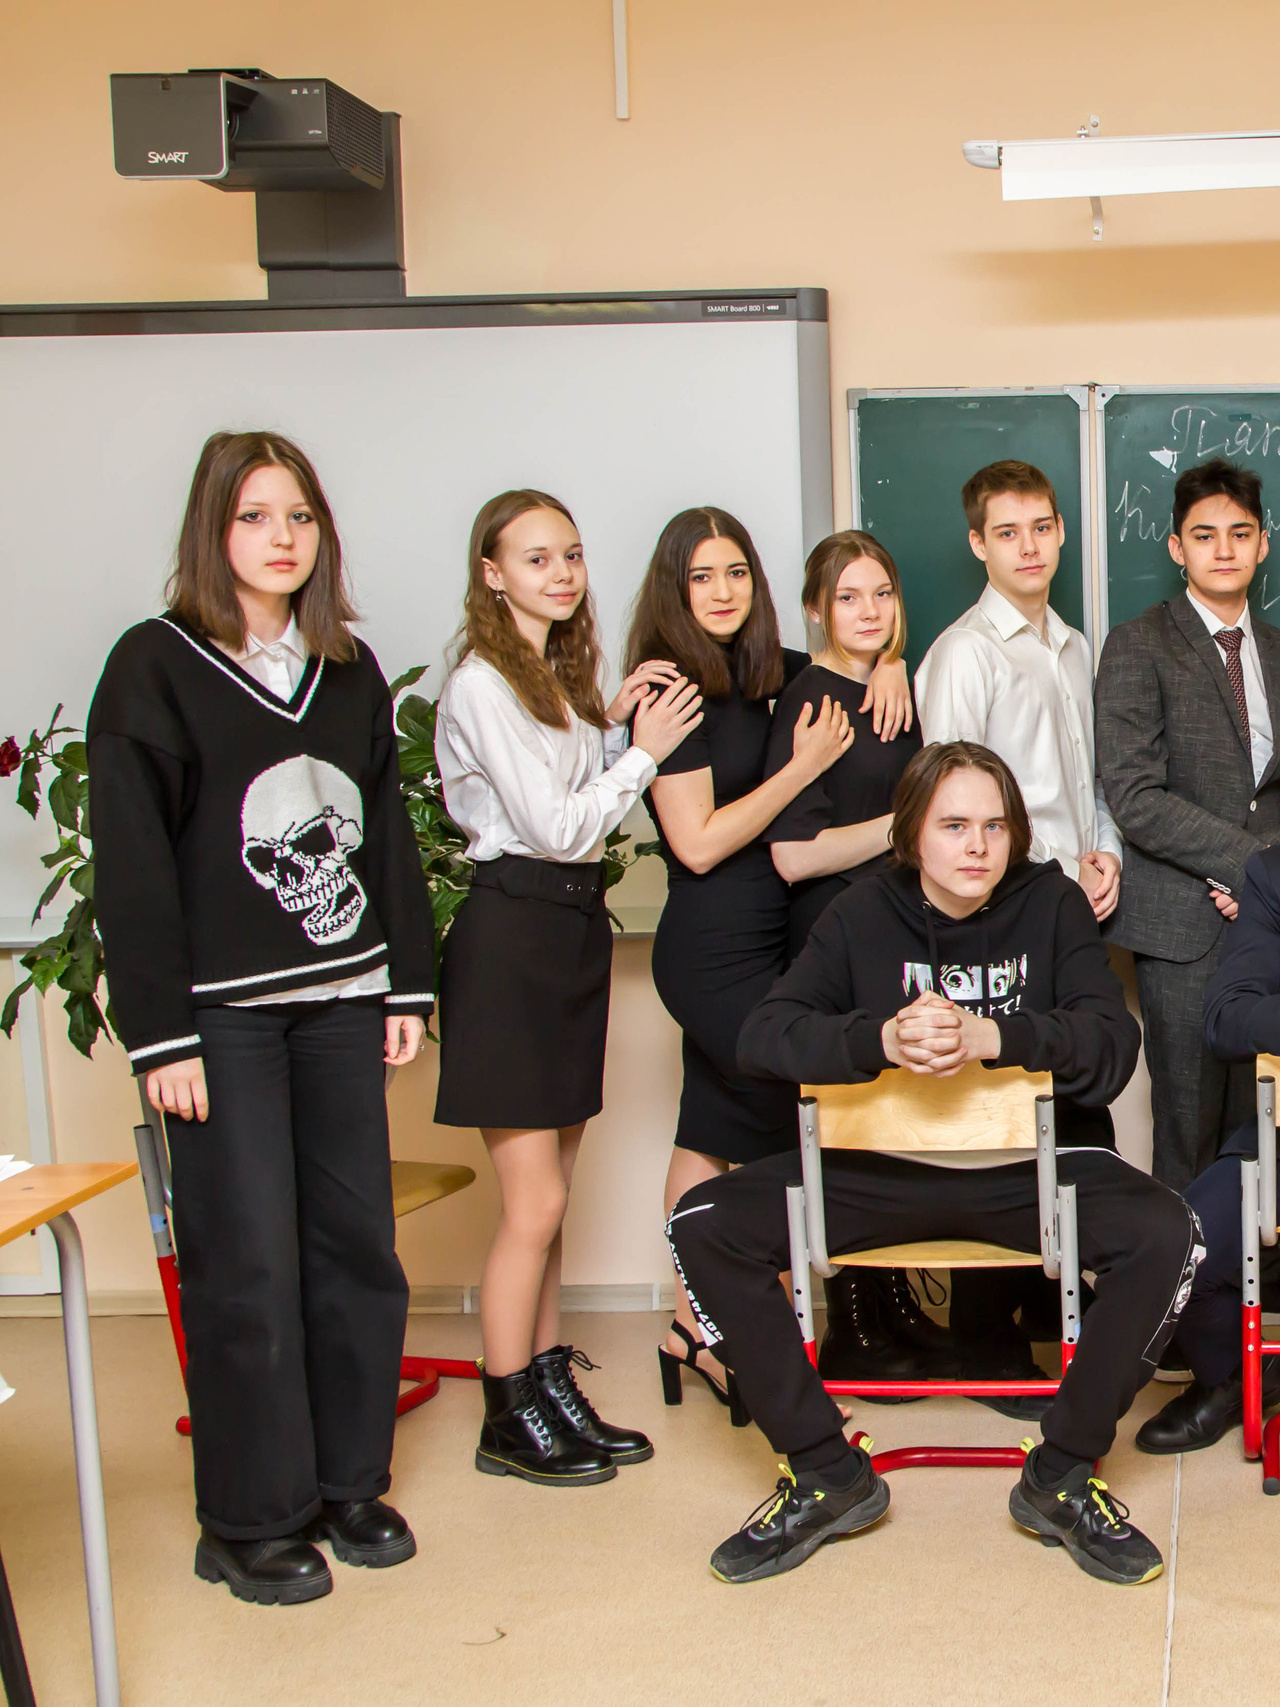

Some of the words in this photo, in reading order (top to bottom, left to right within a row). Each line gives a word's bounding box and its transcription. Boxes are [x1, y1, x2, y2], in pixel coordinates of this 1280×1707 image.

[147, 151, 189, 163] SMART
[706, 305, 729, 313] SMART
[749, 304, 761, 312] 800
